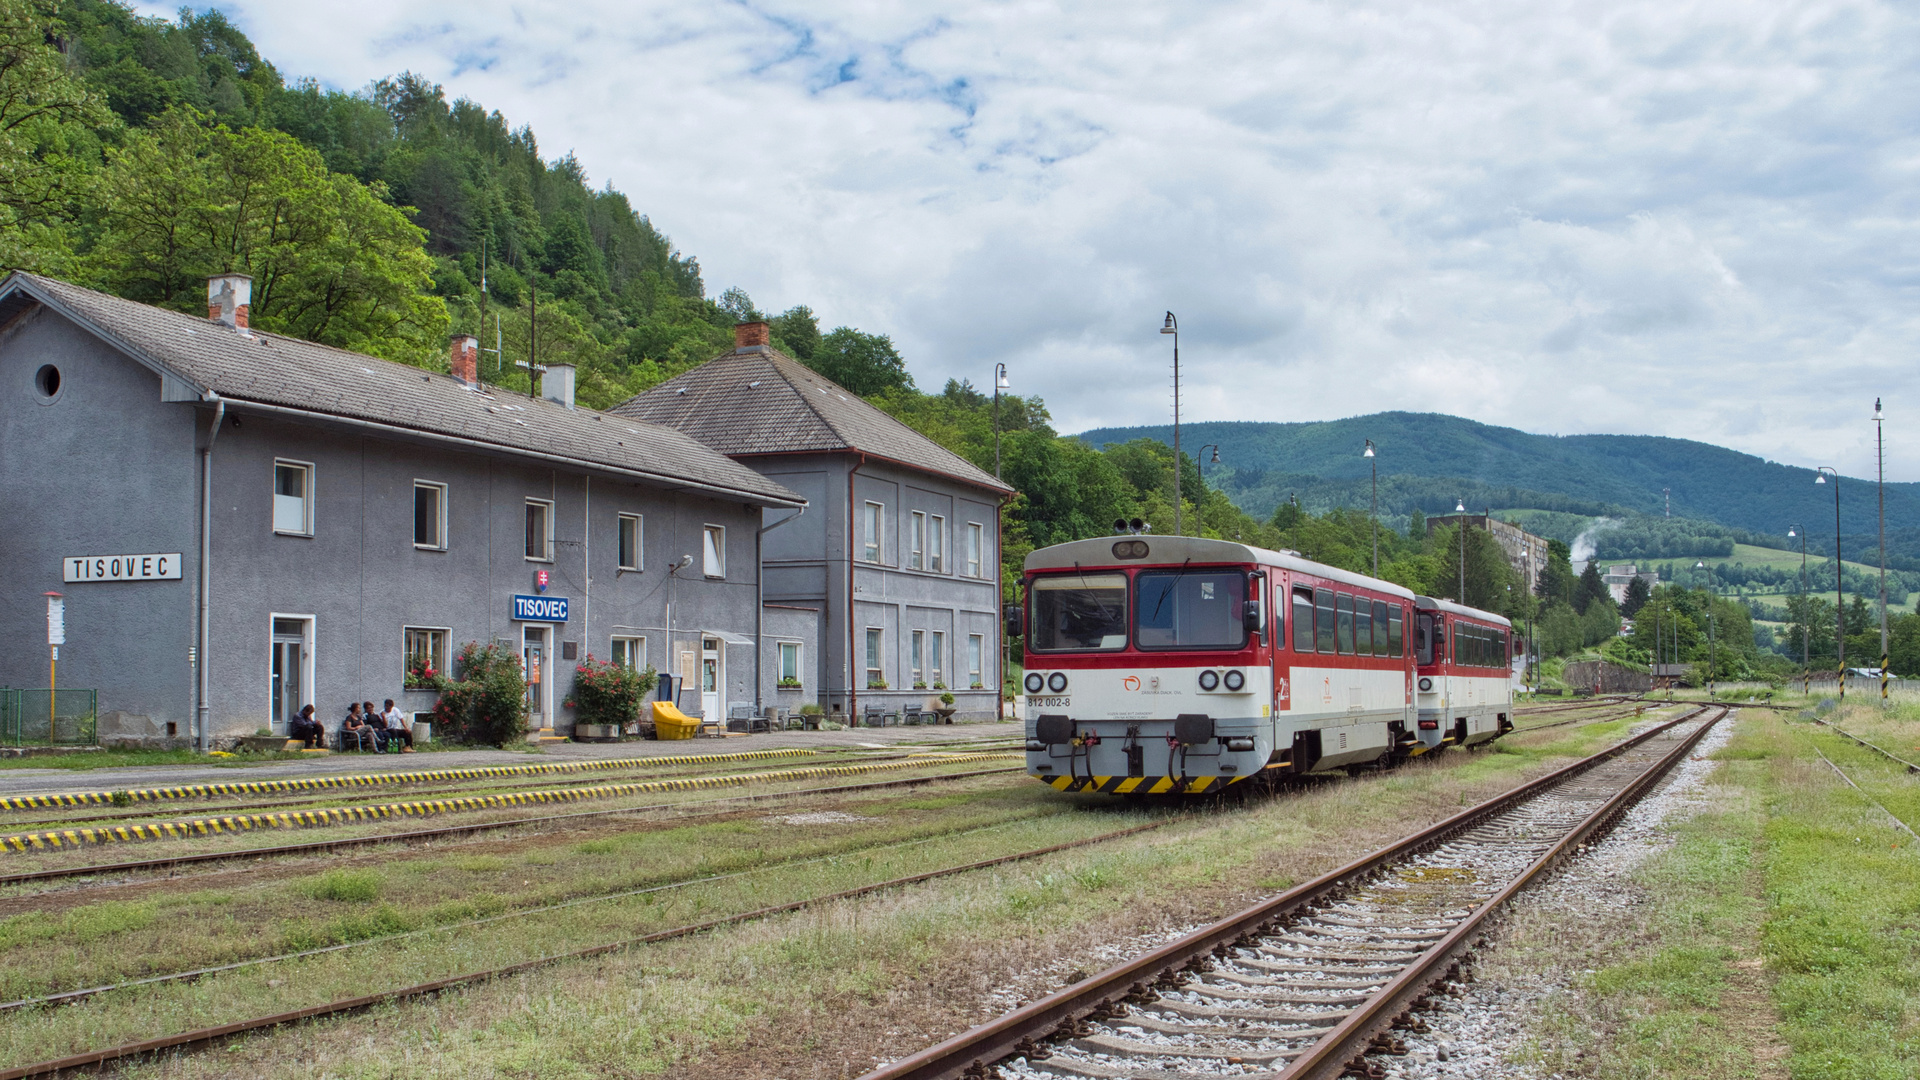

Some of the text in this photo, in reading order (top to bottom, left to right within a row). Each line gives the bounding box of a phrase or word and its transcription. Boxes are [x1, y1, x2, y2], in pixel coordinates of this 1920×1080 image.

[73, 557, 168, 579] TISOVEC
[516, 598, 567, 618] TISOVEC
[1028, 698, 1071, 707] 812 002-8
